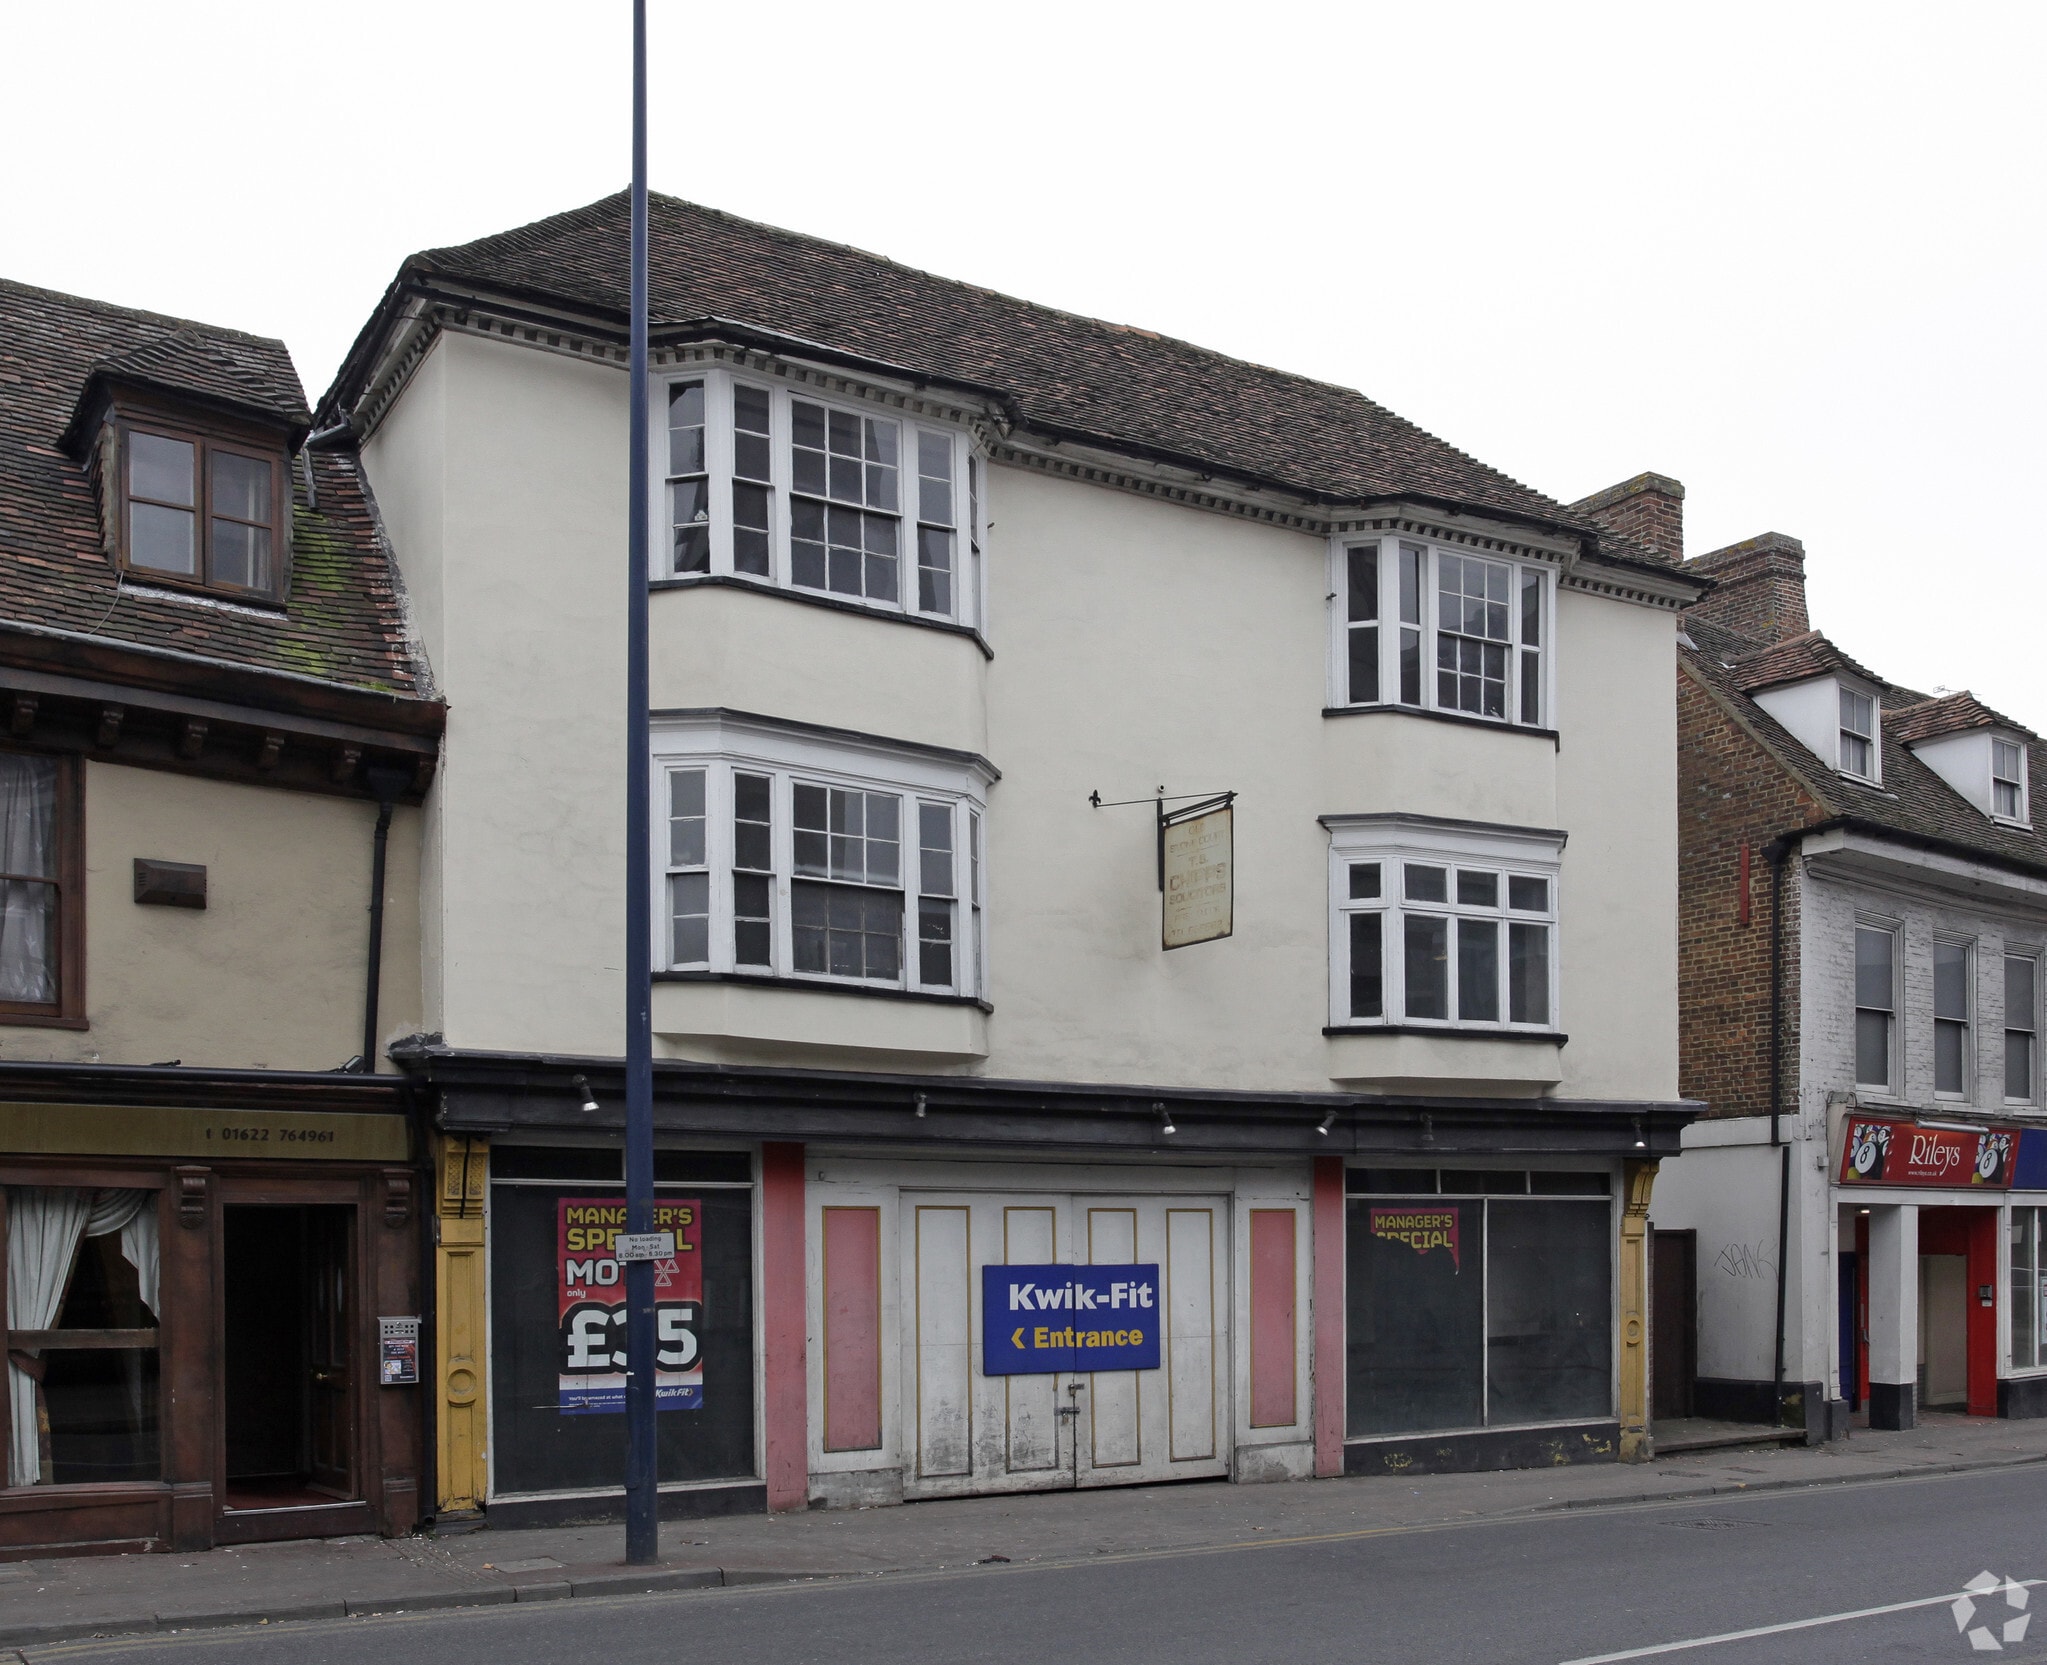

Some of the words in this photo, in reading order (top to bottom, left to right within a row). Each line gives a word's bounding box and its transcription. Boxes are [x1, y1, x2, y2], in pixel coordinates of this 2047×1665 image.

[222, 1127, 270, 1141] 01622
[279, 1129, 334, 1142] 764961
[1908, 1134, 1961, 1176] Rileys
[567, 1207, 693, 1225] MANAR'S
[1375, 1215, 1453, 1229] MANAGER'S
[567, 1228, 693, 1251] SPEL
[566, 1259, 627, 1286] MO
[566, 1289, 586, 1299] only
[1009, 1281, 1153, 1311] Kwik-Fit
[1034, 1326, 1144, 1349] Entrance
